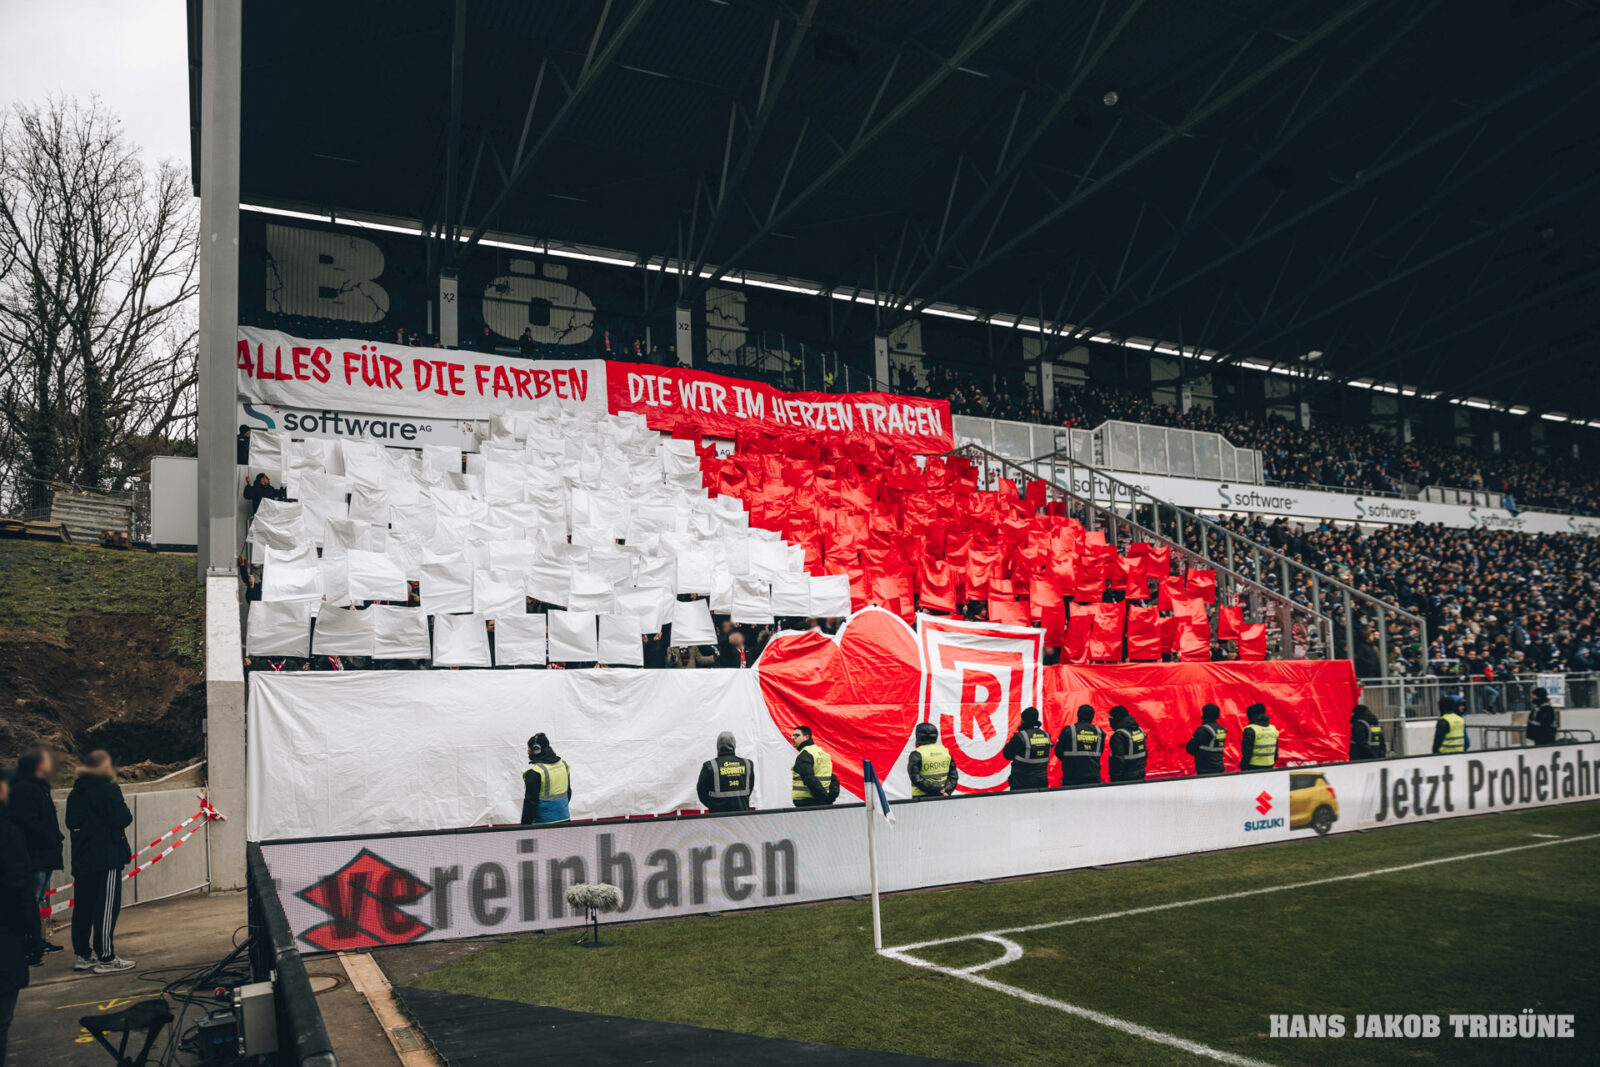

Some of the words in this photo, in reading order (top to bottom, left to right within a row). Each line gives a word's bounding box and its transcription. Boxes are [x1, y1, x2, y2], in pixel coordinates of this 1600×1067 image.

[443, 292, 455, 301] X2
[679, 322, 689, 330] X2
[238, 339, 331, 384] ALLES
[343, 345, 403, 390] FÜR
[413, 359, 466, 396] DIE
[474, 365, 588, 402] FARBEN
[627, 372, 673, 407] DIE
[678, 378, 727, 415] WIR
[731, 385, 764, 420] IM
[772, 397, 852, 433] HERZEN
[855, 402, 943, 436] TRAGEN
[284, 410, 418, 440] software
[419, 424, 432, 433] AG
[1235, 491, 1292, 509] software
[1368, 503, 1417, 520] software
[720, 766, 746, 776] SECURITY
[923, 761, 950, 771] ORDNER
[1375, 765, 1454, 822] Jetzt
[1244, 818, 1285, 832] SUZUKI
[319, 832, 800, 941] vereinbaren
